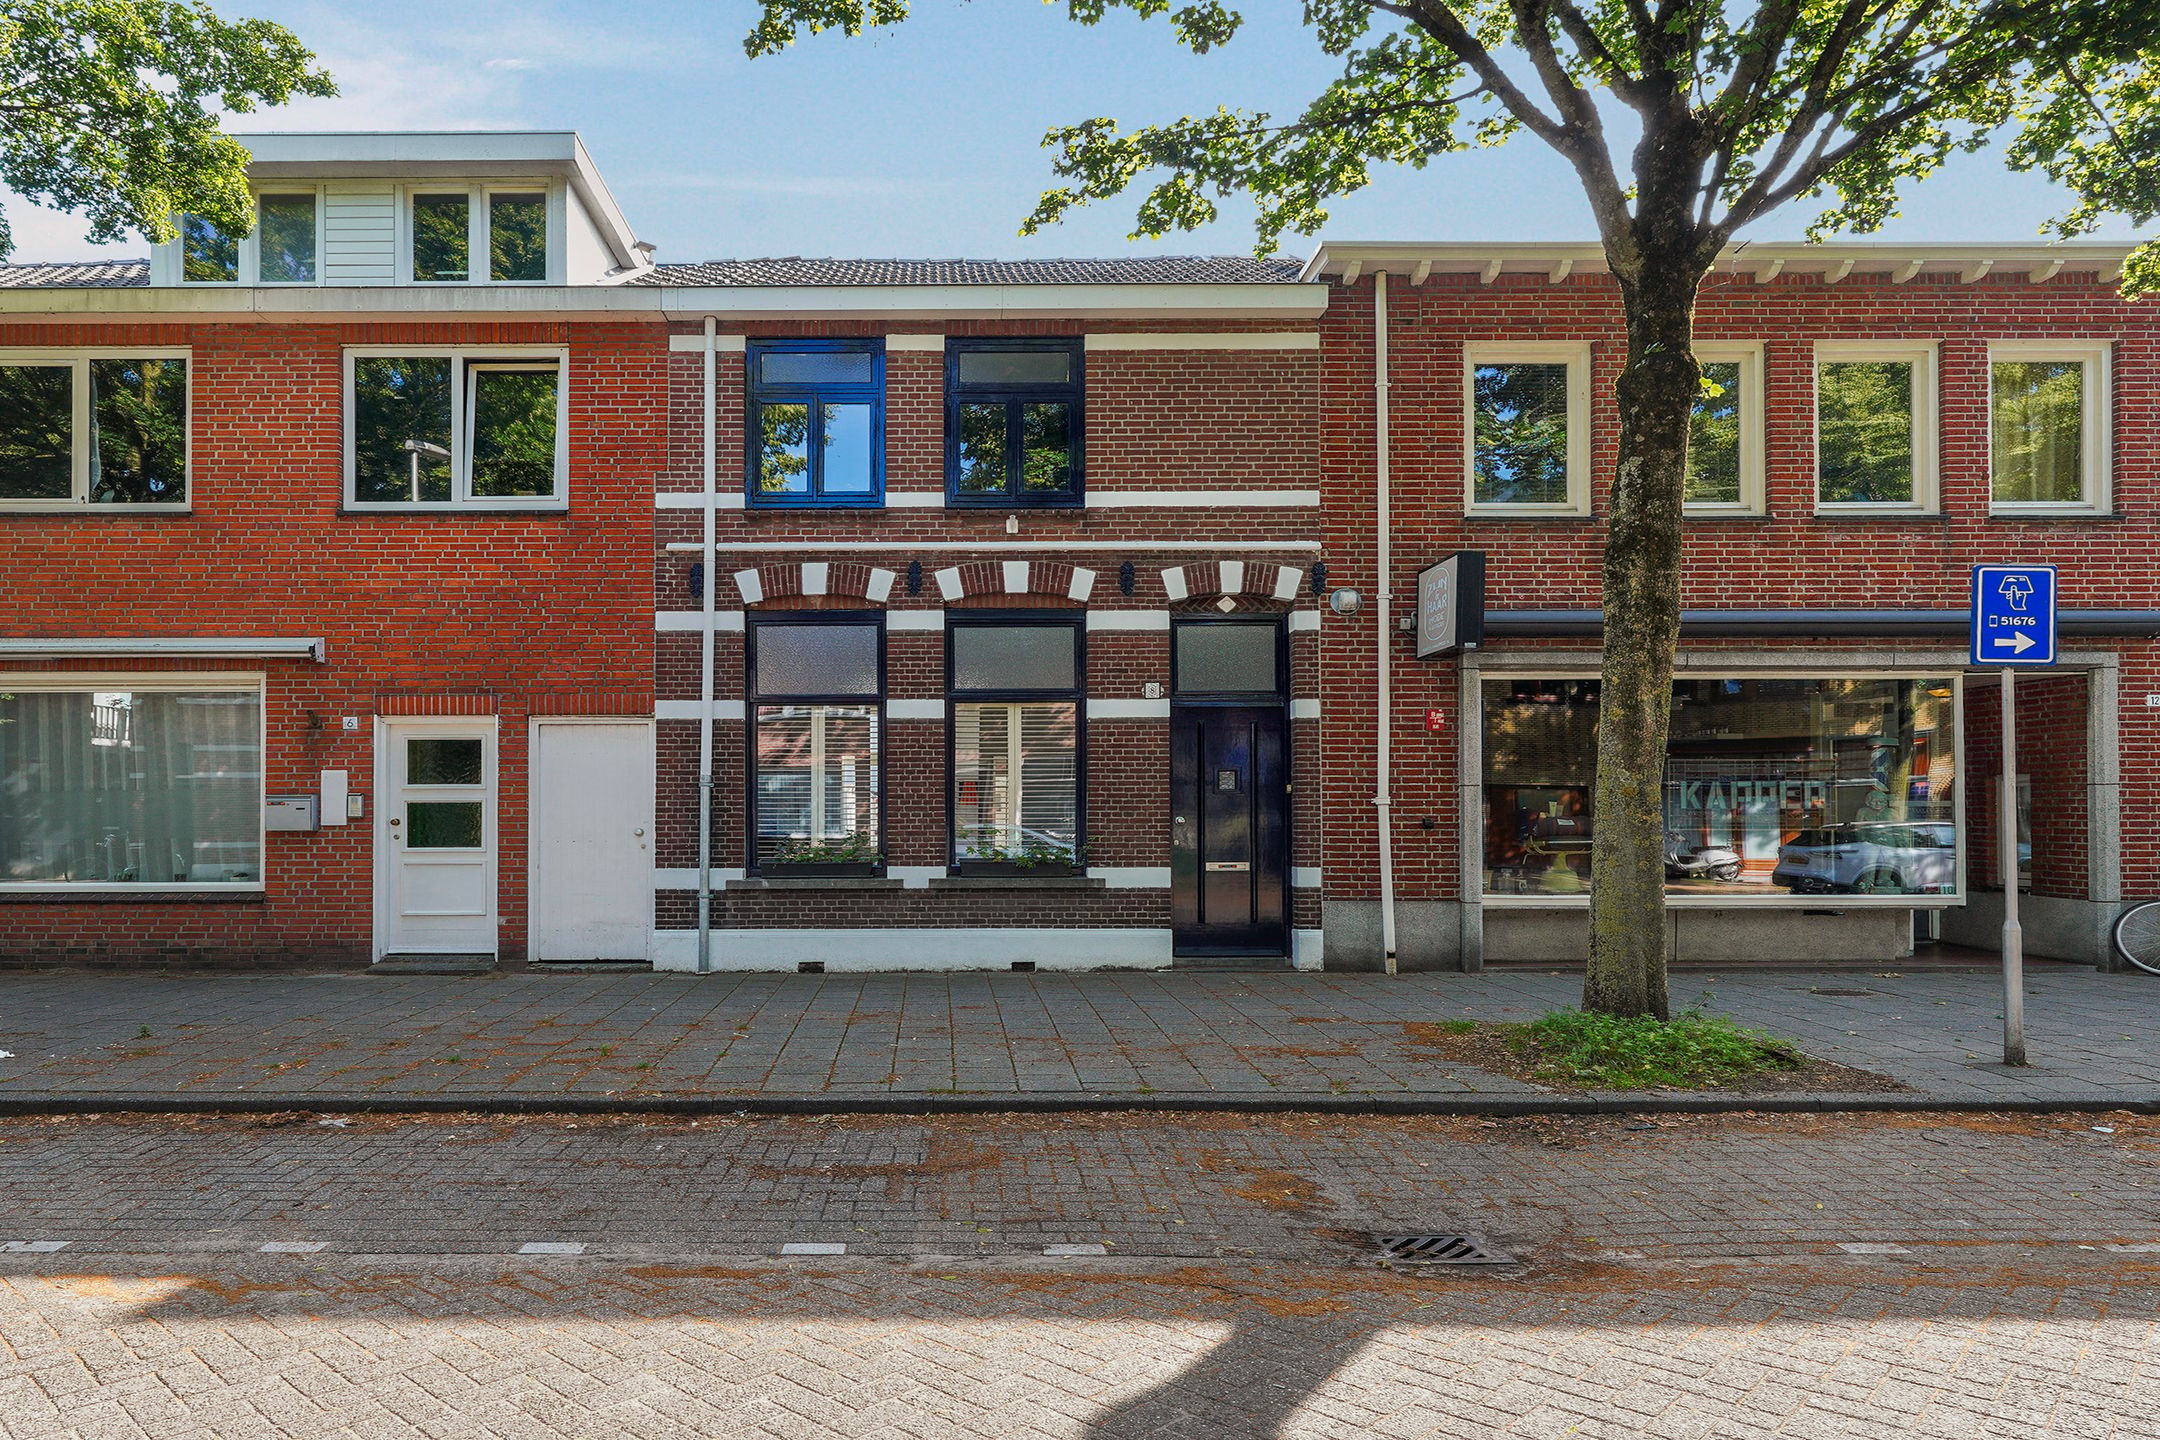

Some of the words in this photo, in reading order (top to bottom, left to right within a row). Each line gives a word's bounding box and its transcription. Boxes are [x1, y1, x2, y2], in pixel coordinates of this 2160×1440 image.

[1426, 594, 1447, 614] HAAR
[2000, 616, 2036, 626] 51676
[2151, 696, 2160, 705] 12
[347, 719, 353, 727] 6
[1680, 780, 1825, 809] KAPPER
